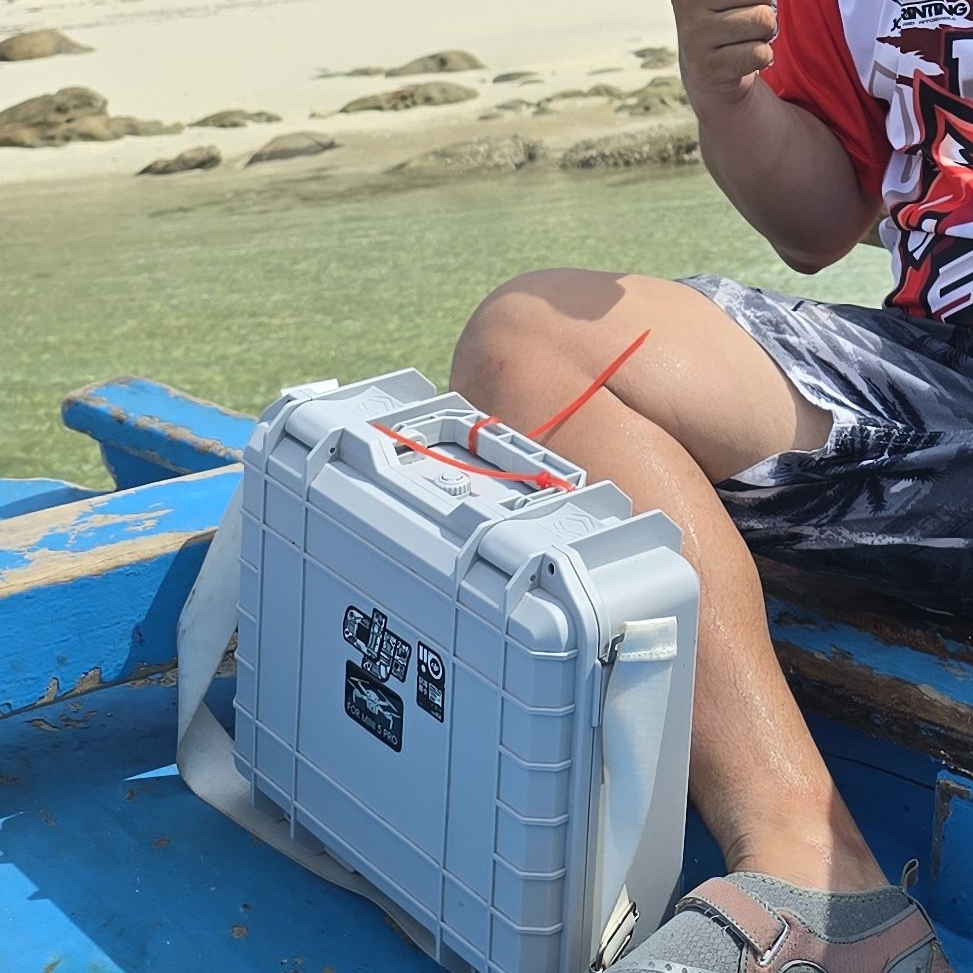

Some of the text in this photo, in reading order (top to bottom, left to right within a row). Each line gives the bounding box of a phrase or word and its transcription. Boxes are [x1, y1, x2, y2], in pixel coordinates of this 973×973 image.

[901, 2, 968, 20] RINTING
[347, 701, 361, 719] FOR
[383, 728, 398, 746] PRO
